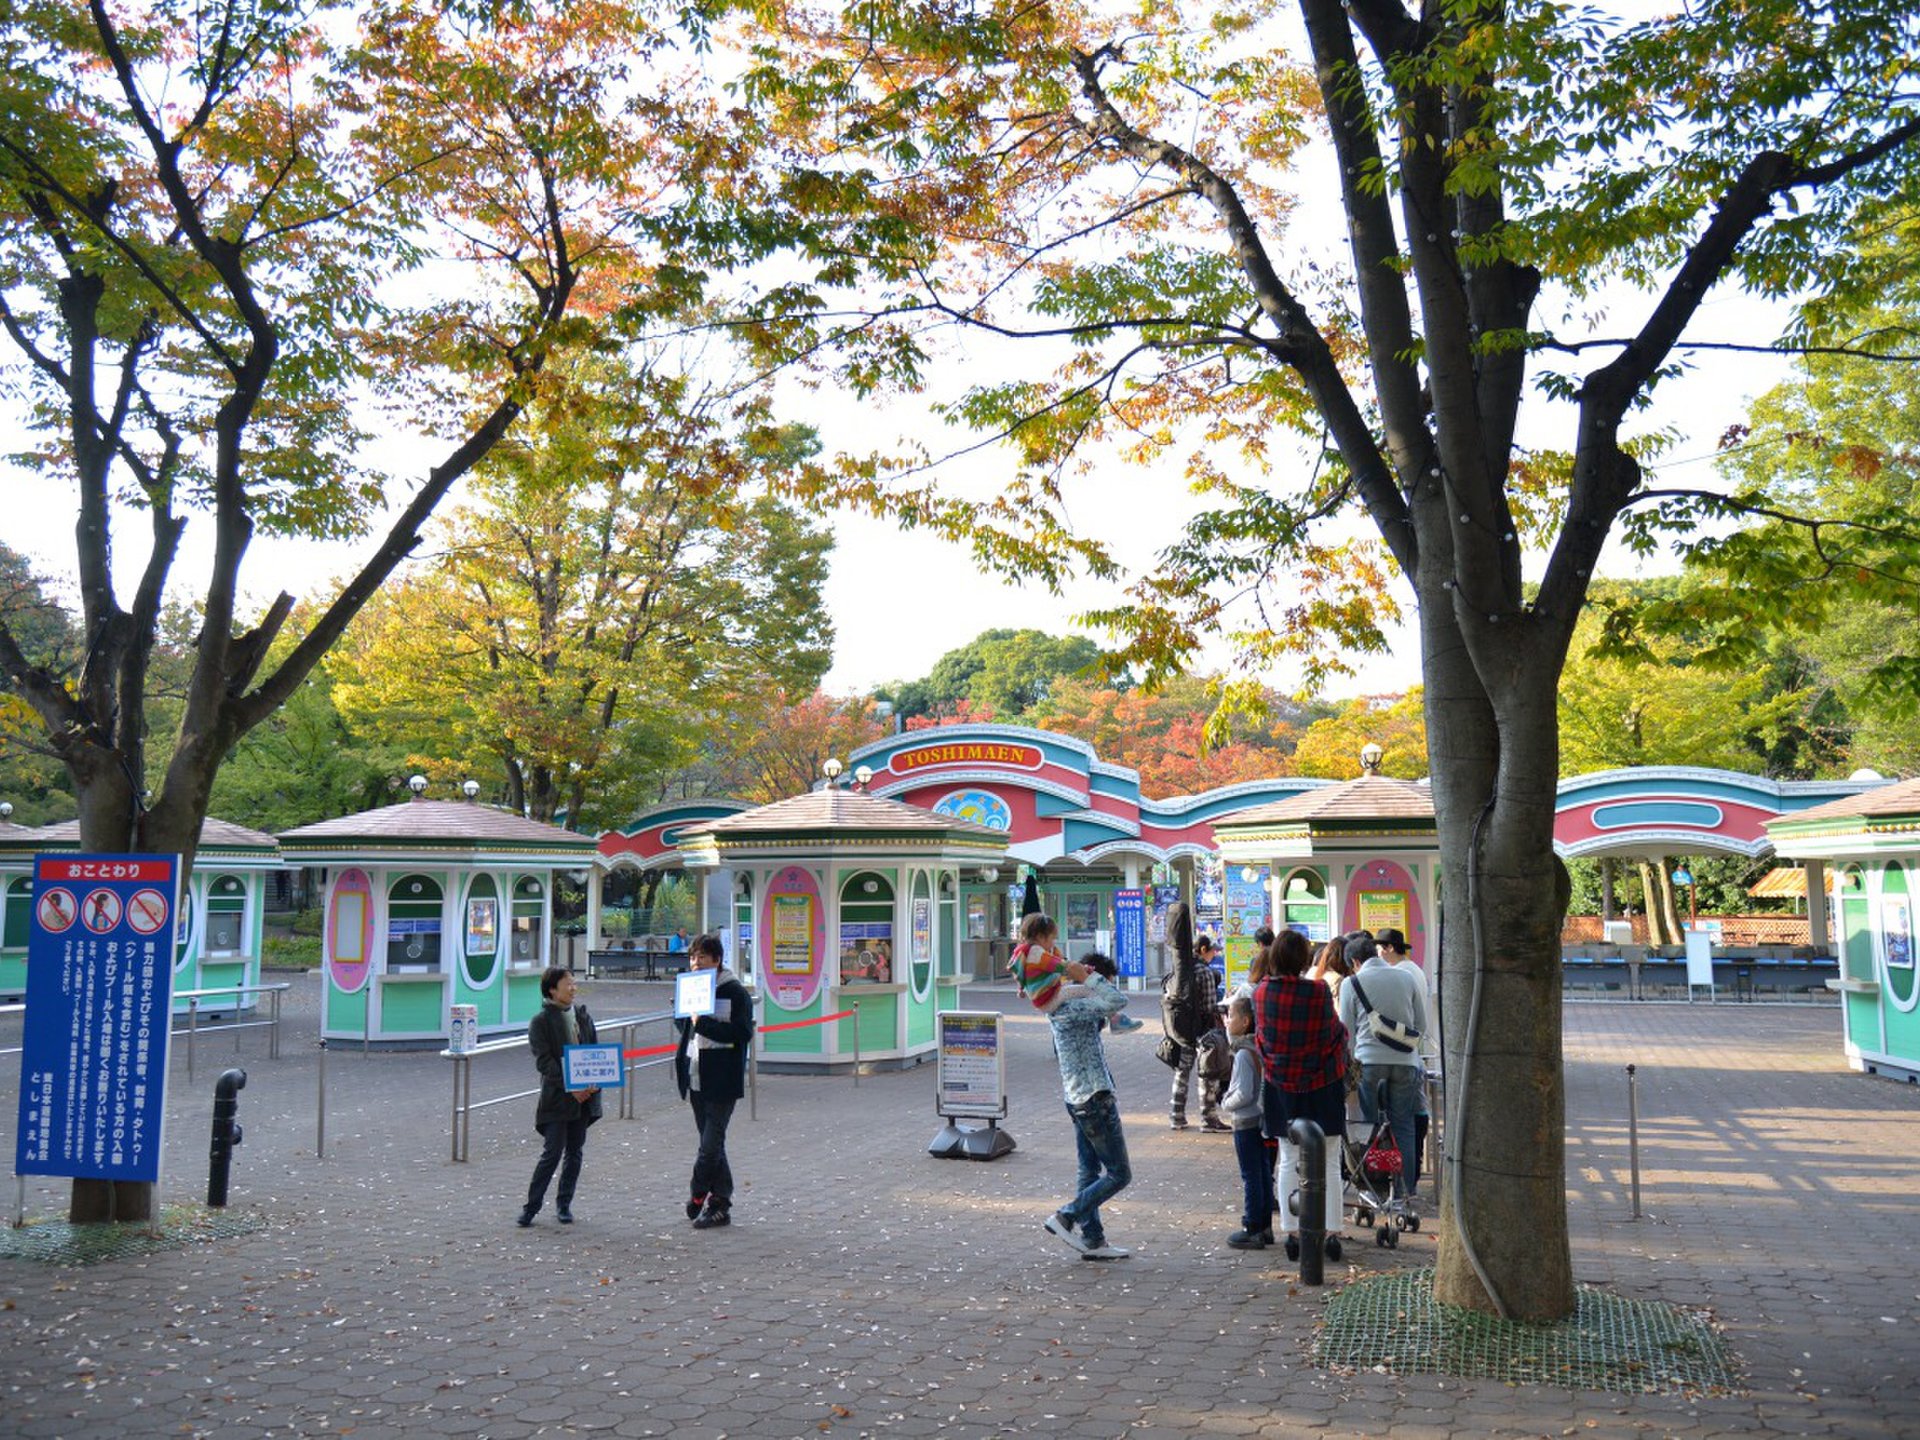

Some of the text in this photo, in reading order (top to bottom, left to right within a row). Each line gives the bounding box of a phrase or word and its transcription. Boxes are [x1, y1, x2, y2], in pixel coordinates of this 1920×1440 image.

[904, 746, 1026, 767] TOSHIMAEN
[68, 864, 140, 878] おことわり
[25, 1072, 41, 1161] としまえん
